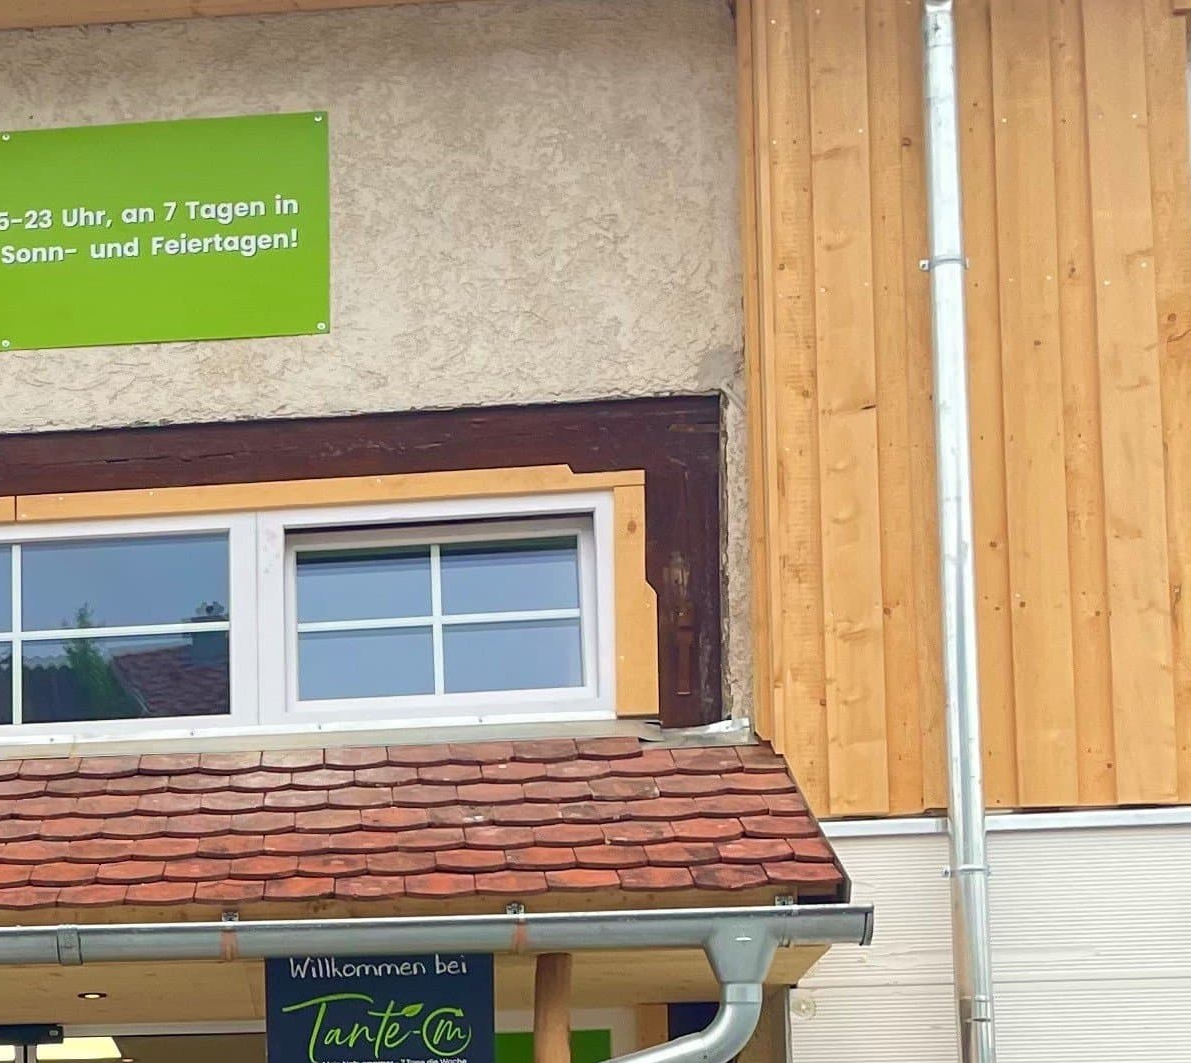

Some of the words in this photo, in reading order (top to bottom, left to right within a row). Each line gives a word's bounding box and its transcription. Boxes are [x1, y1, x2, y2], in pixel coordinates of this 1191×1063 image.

[62, 206, 113, 228] Uhr,
[121, 205, 155, 224] an
[163, 201, 177, 221] 7
[185, 200, 266, 225] Tagen
[275, 194, 299, 215] in
[1, 244, 77, 264] Sonn-
[90, 237, 139, 259] und
[151, 228, 299, 257] Feiertagen!
[290, 957, 426, 979] Willkommen
[435, 954, 467, 975] bei
